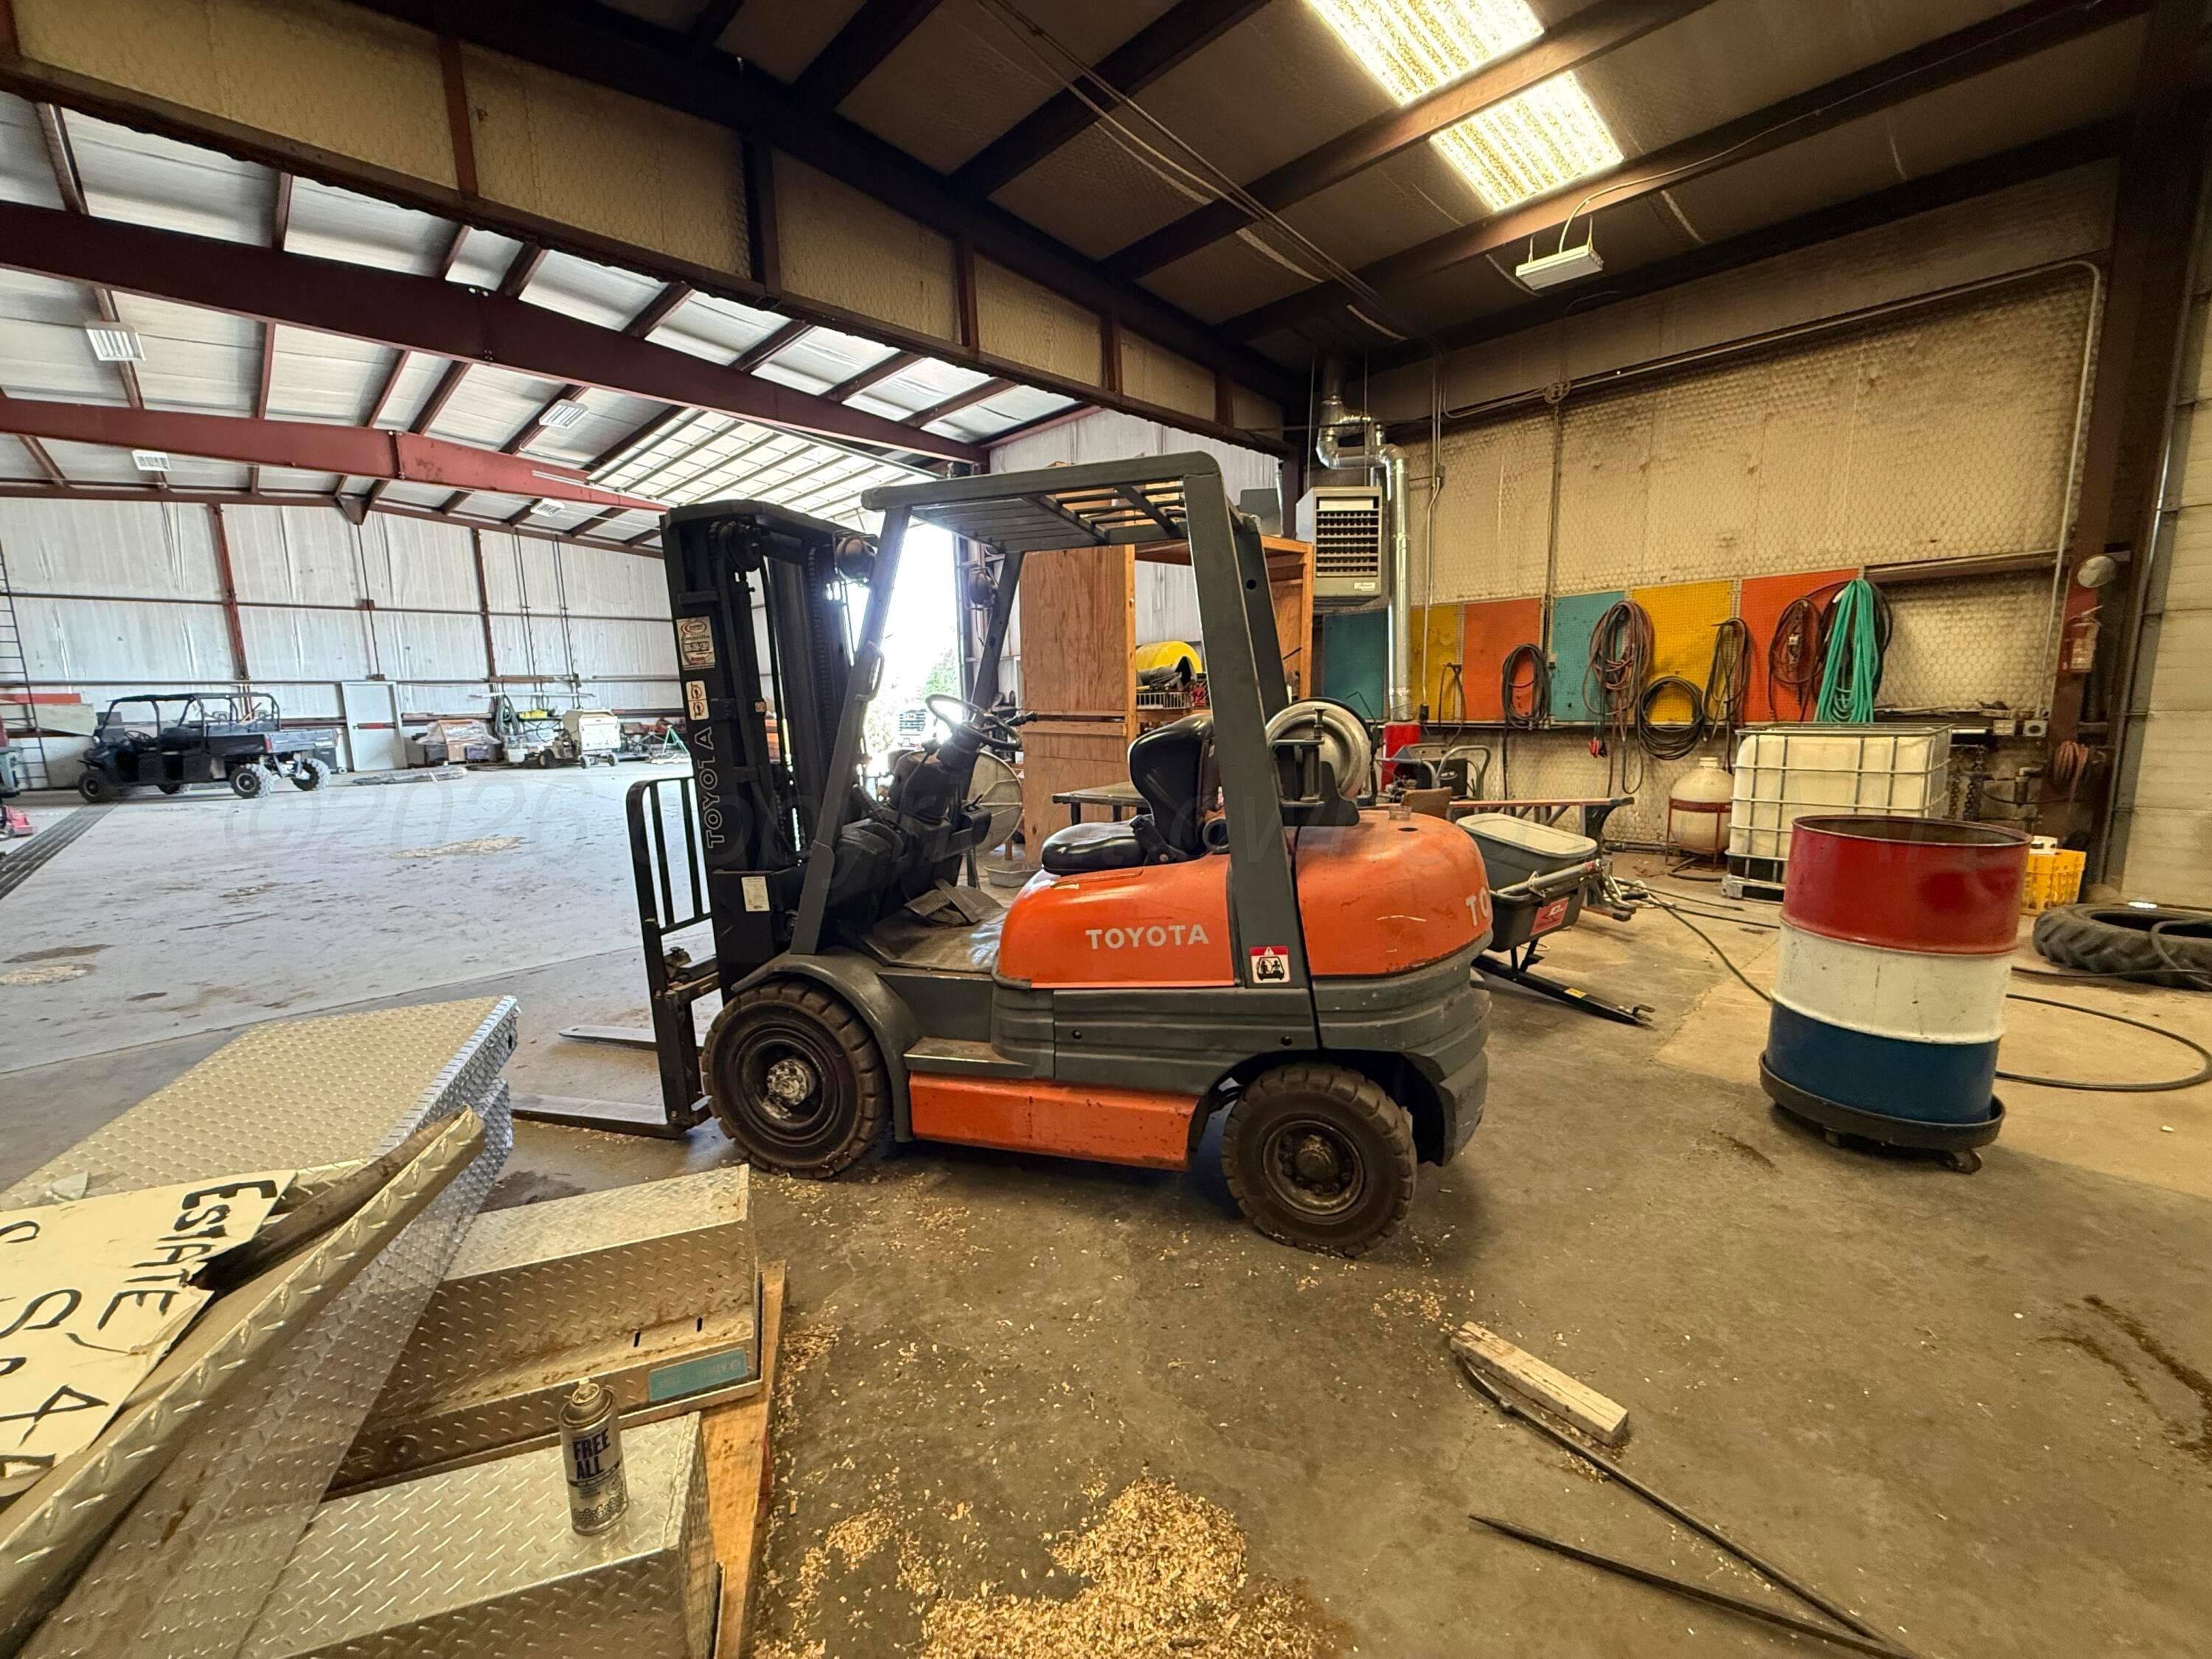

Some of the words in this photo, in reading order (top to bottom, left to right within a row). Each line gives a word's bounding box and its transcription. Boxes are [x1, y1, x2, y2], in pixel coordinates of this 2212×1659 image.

[695, 726, 725, 849] TOYOTA
[1085, 924, 1209, 950] TOYOTA
[572, 1427, 611, 1461] FREE
[577, 1455, 604, 1480] ALL
